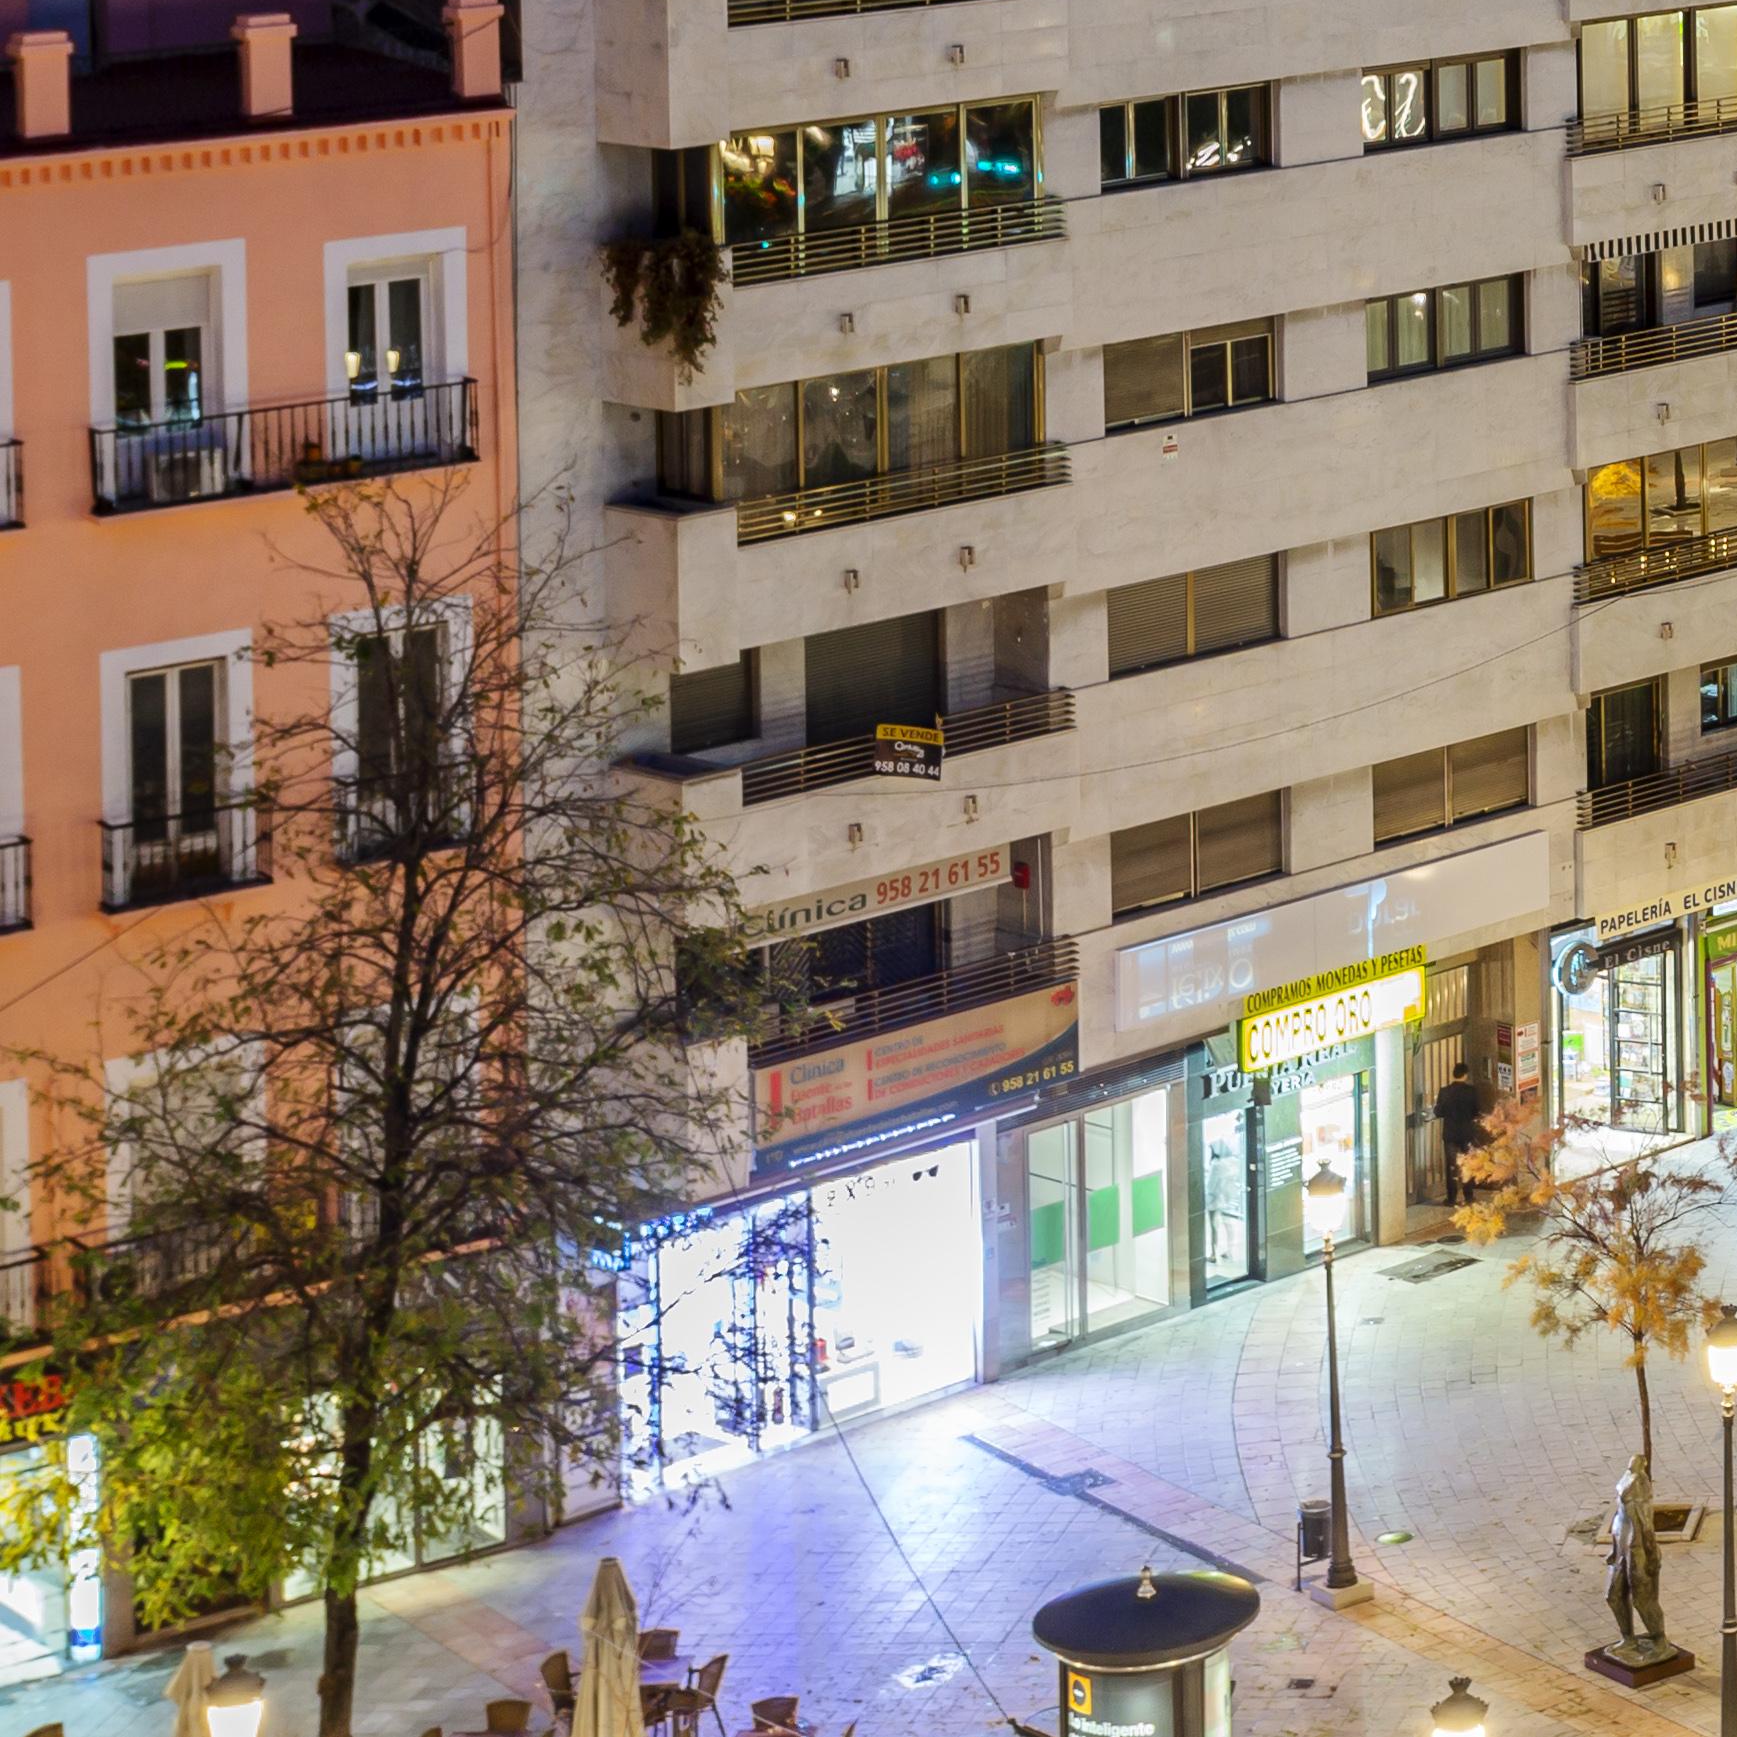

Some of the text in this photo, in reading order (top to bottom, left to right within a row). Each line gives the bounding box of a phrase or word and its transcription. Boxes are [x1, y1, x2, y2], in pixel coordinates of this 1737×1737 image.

[882, 727, 939, 742] SE VENDE
[875, 760, 940, 777] 958 08 40 44
[876, 875, 912, 905] 958
[918, 868, 941, 893] 21
[947, 859, 970, 885] 61
[977, 851, 1000, 878] 55
[1600, 897, 1672, 935] PAPELERÍA
[1683, 893, 1700, 910] EL
[1604, 938, 1671, 969] El Cisne
[1247, 945, 1423, 1014] COMPRAMOS MONEDAS Y PESETAS
[1249, 990, 1372, 1063] COMPRO ORO
[1002, 1060, 1075, 1093] 958 21 61 55
[1080, 1716, 1156, 1737] inteligente
